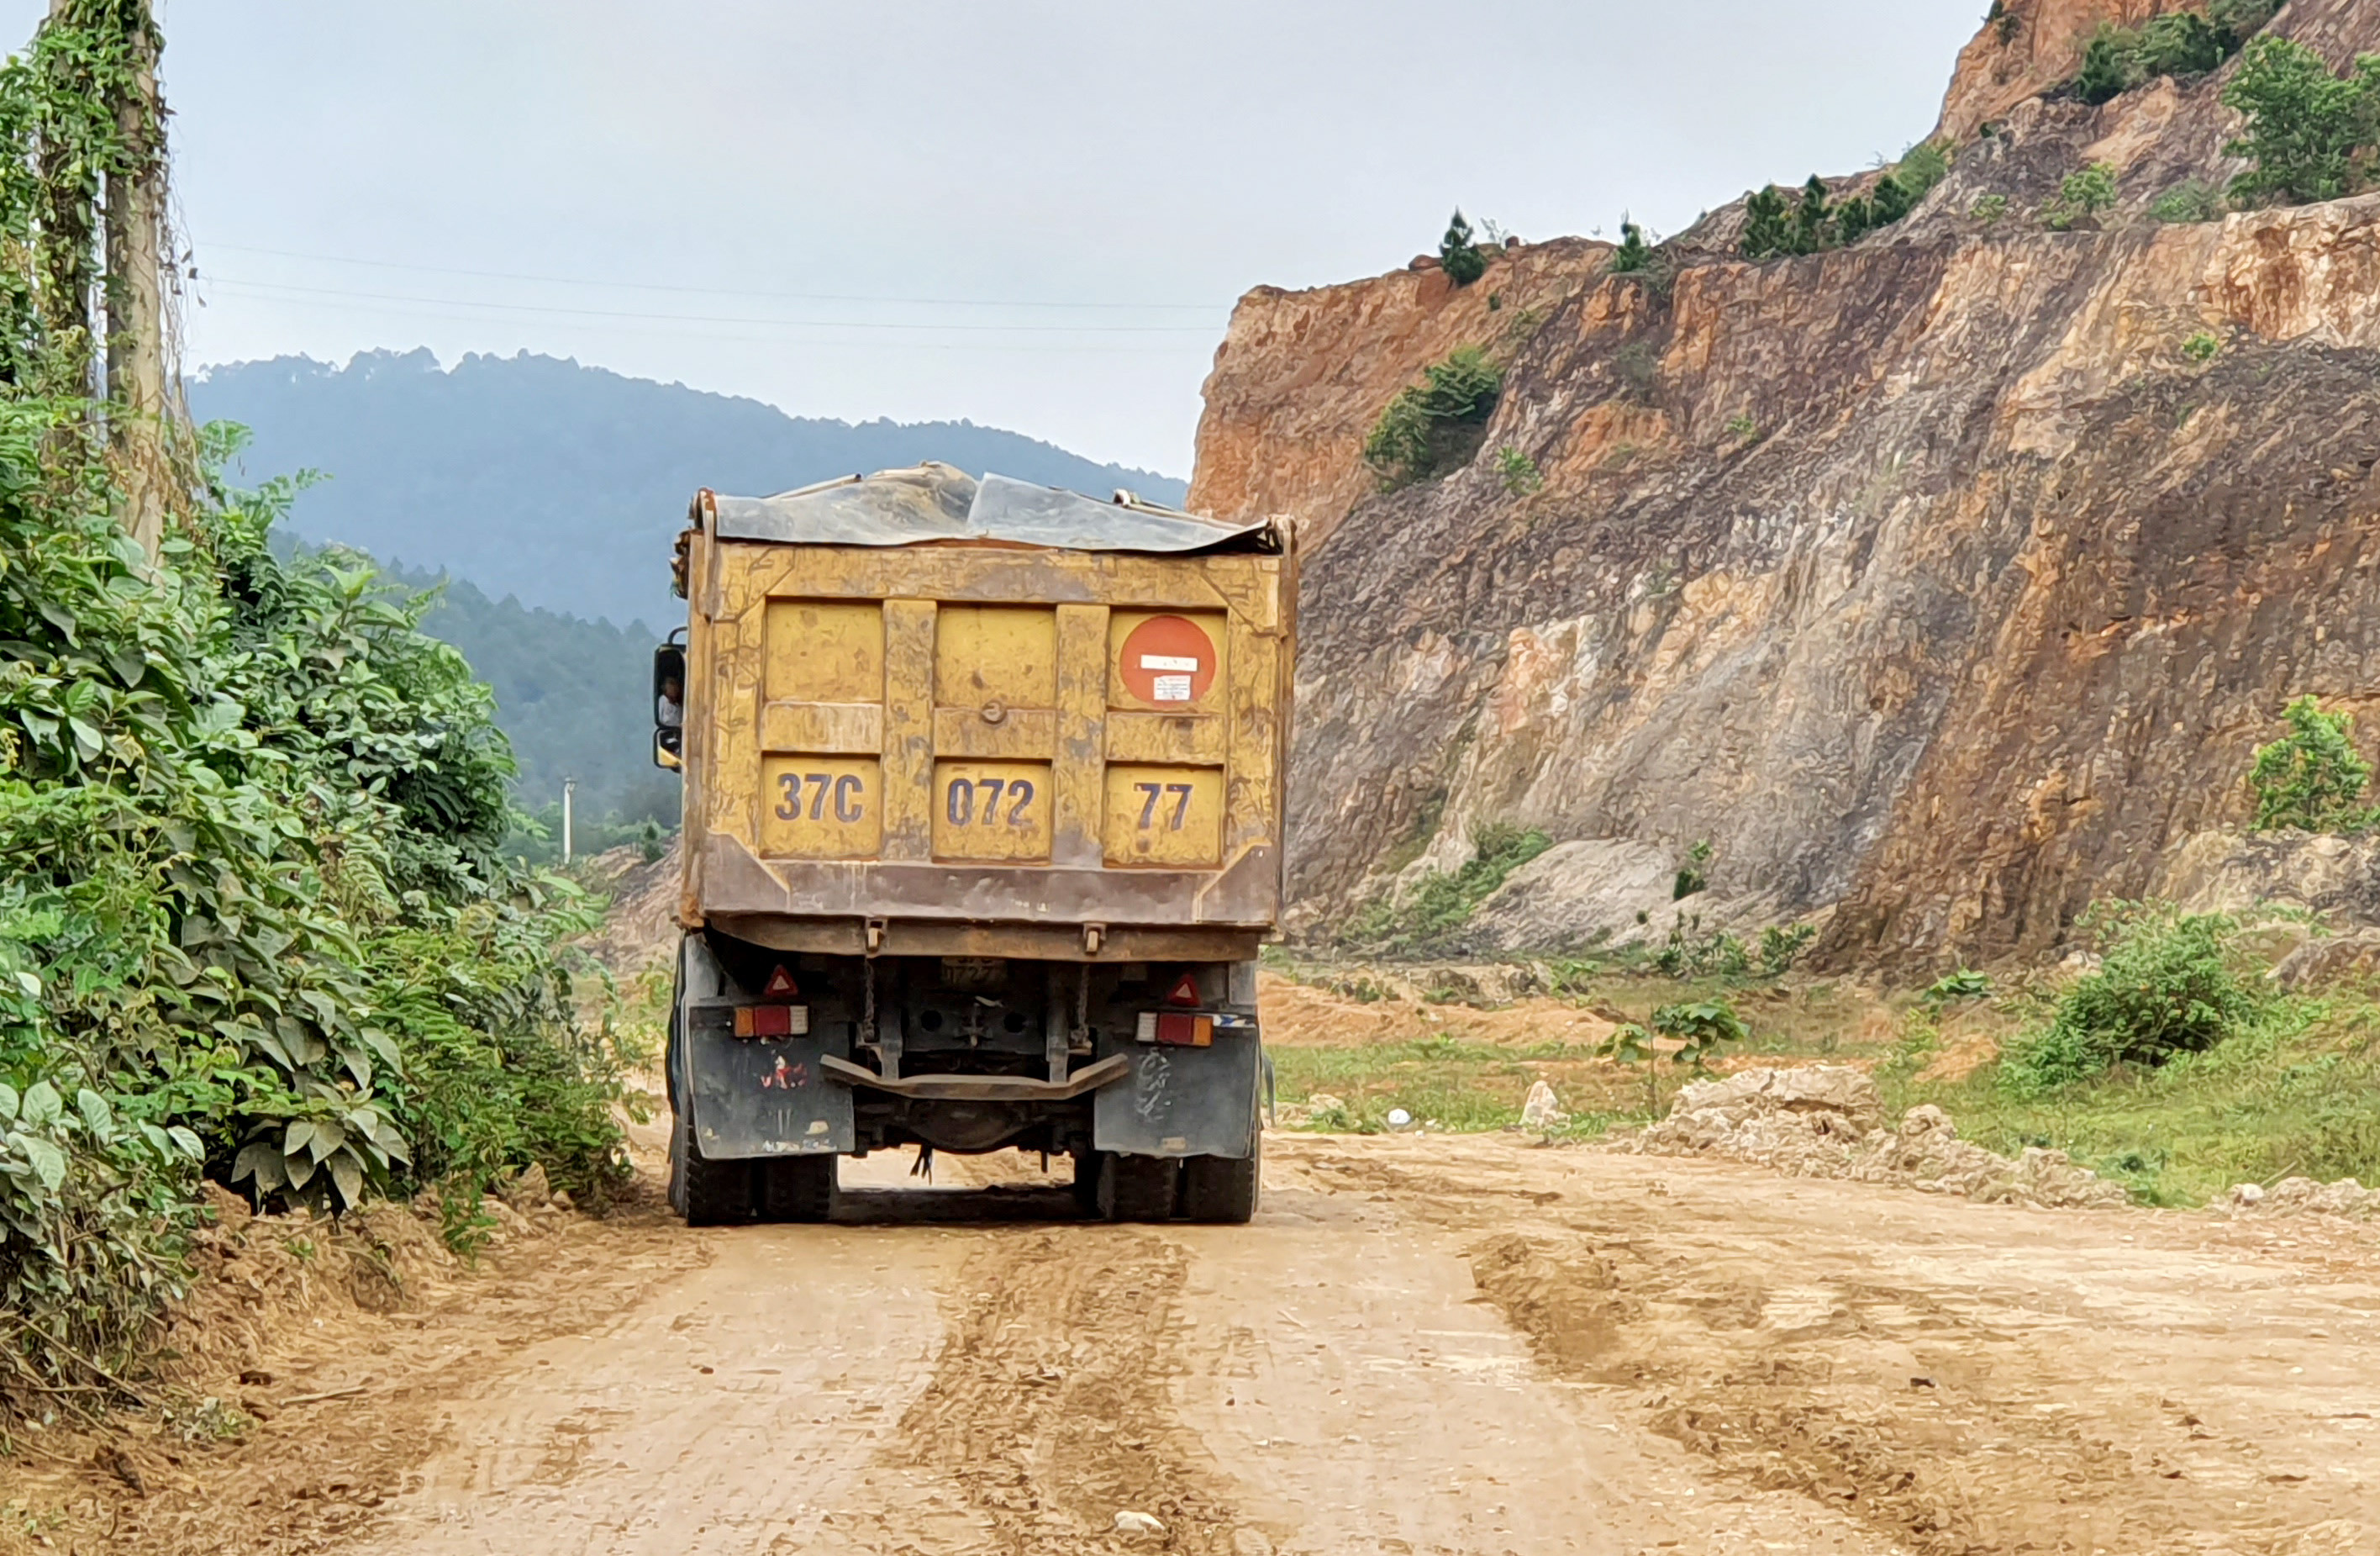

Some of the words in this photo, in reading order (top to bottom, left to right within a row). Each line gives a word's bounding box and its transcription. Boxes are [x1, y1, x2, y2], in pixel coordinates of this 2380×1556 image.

[775, 773, 863, 823] 37C
[947, 778, 1034, 826] 072
[1134, 783, 1193, 831] 77
